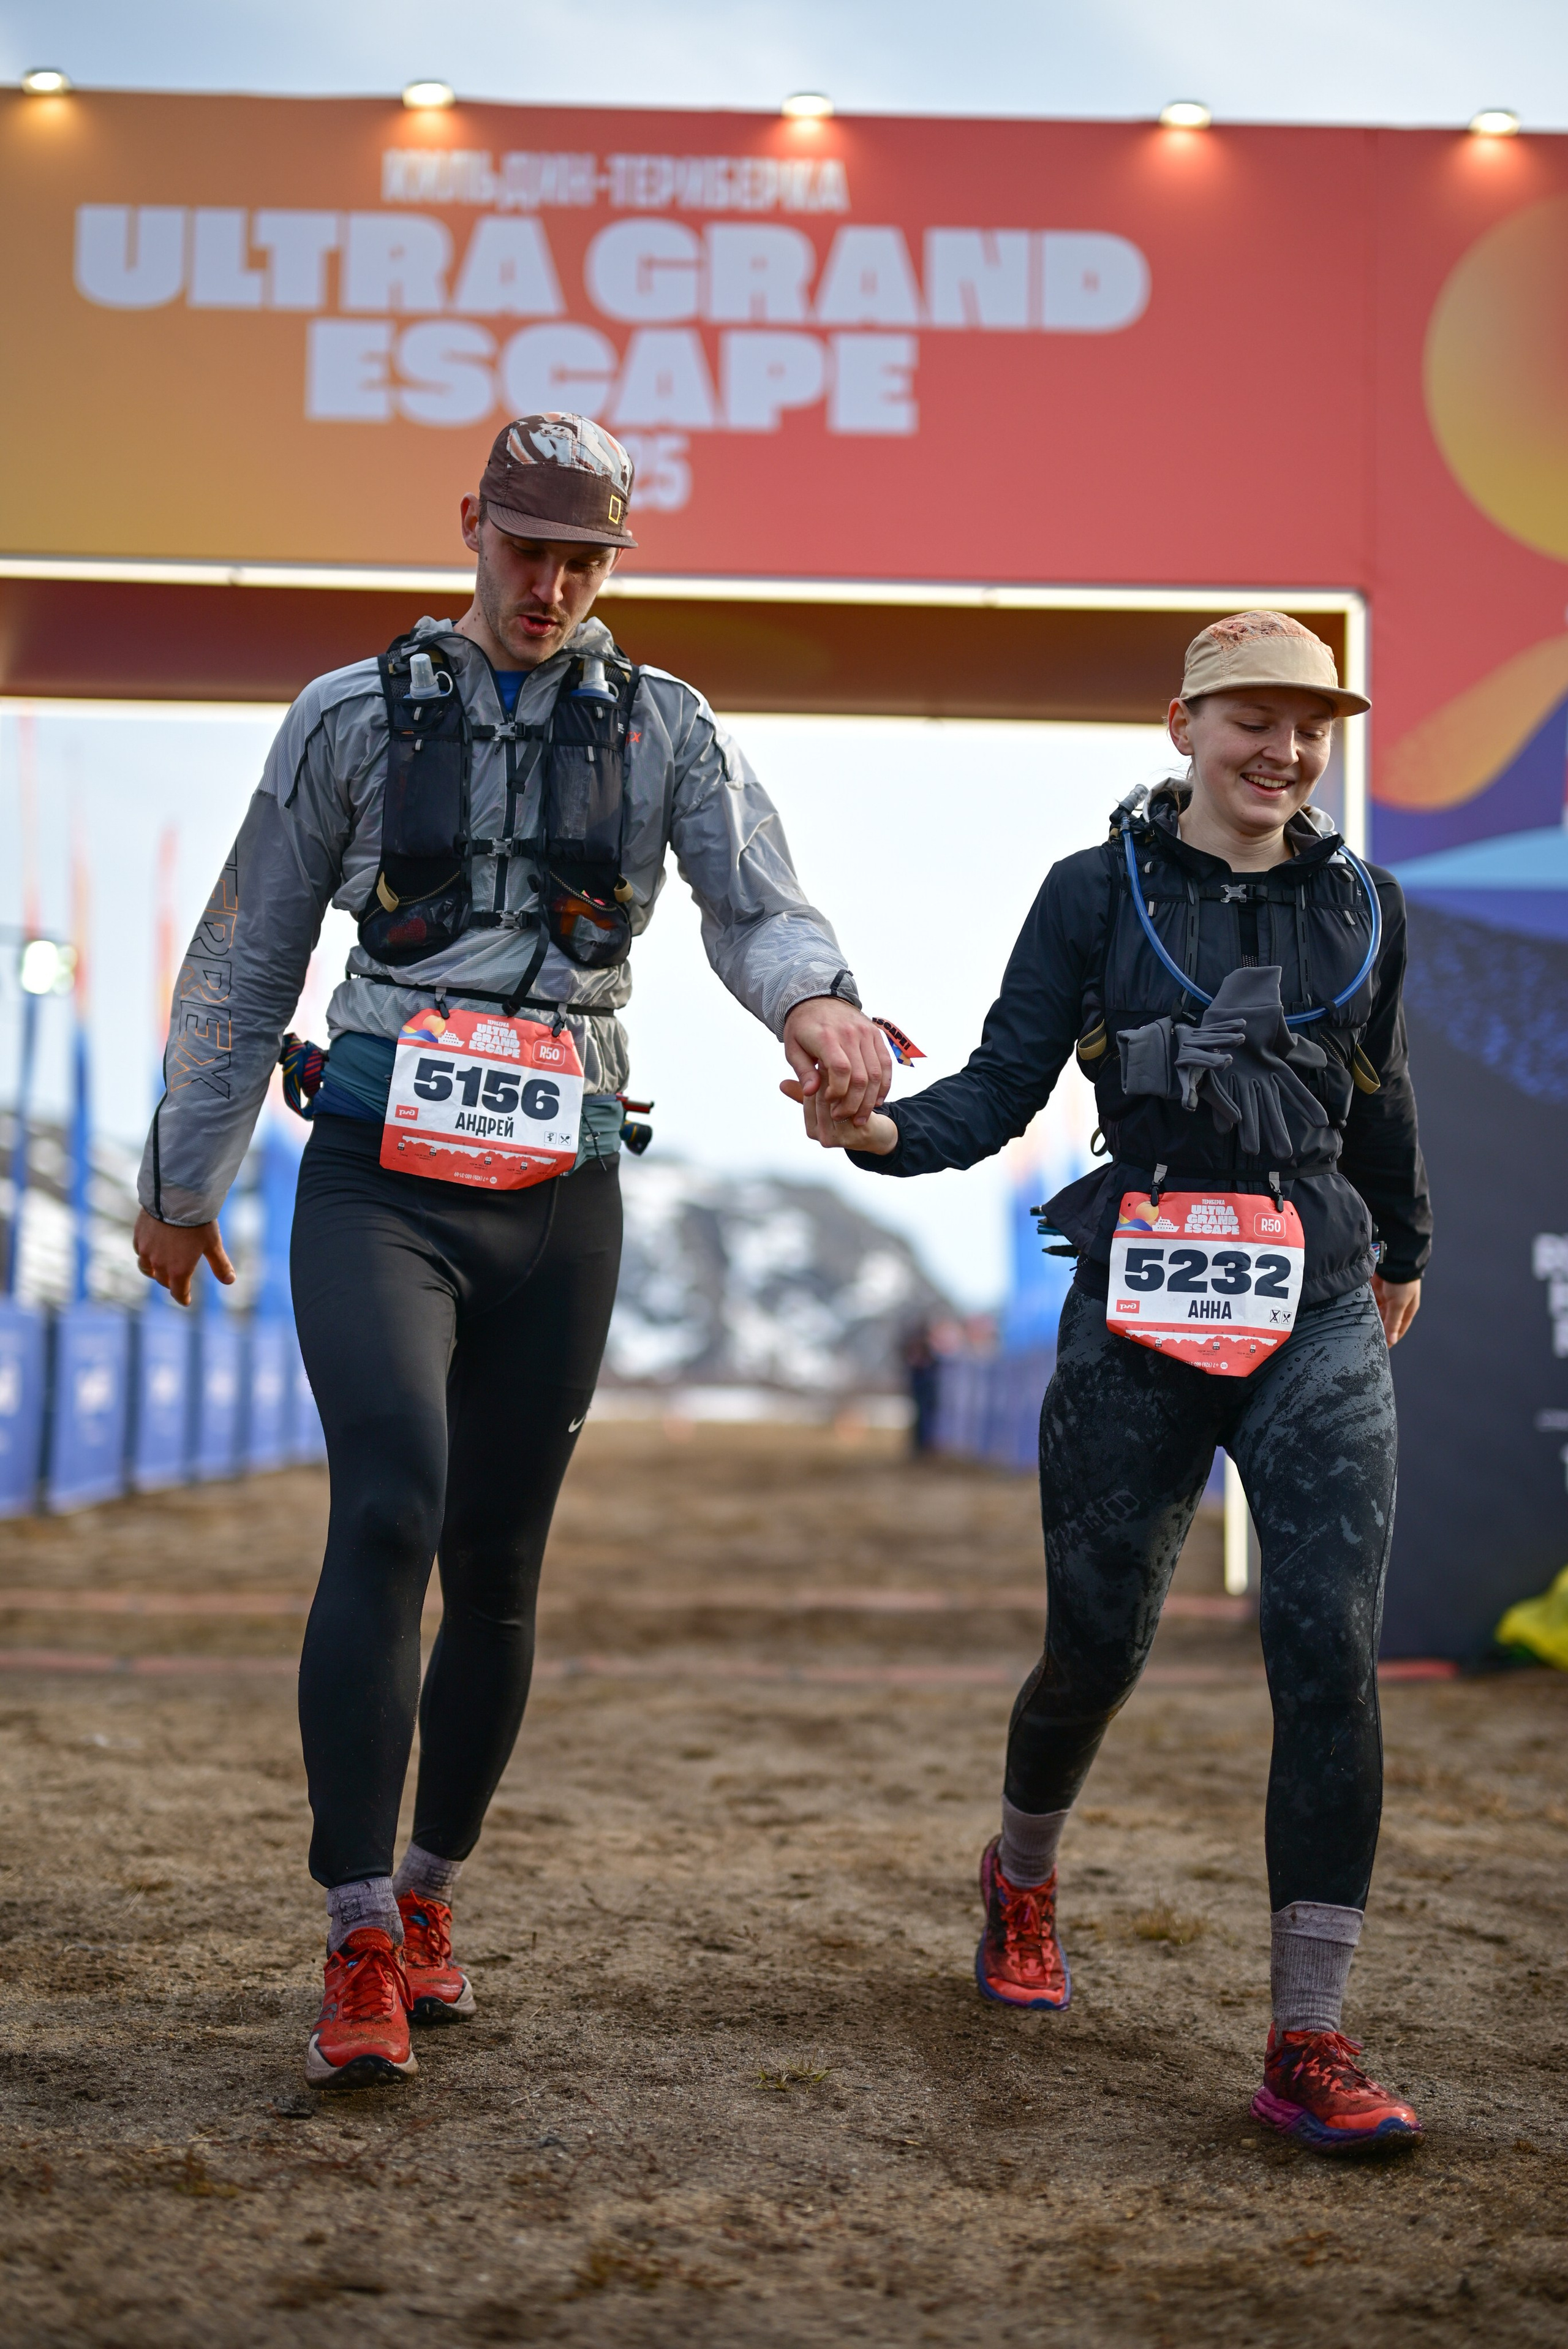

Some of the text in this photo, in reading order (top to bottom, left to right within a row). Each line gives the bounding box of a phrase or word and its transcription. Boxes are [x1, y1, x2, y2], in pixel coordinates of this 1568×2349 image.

[74, 204, 1152, 334] ULTRA GRAND
[305, 318, 918, 436] ESCAPE
[617, 434, 693, 512] 25
[477, 1023, 518, 1040] ULTRA
[488, 1019, 510, 1028] ТЕРИБЕРКА
[472, 1032, 520, 1048] GRAND
[469, 1040, 520, 1059] ESCAPE
[539, 1045, 560, 1061] R50
[413, 1057, 560, 1121] 5156
[455, 1112, 514, 1138] АНДРЕЙ
[1186, 1214, 1238, 1225] GRAND
[1191, 1205, 1235, 1216] ULTRA
[1184, 1224, 1240, 1235] ESCAPE
[1261, 1218, 1281, 1233] R50
[1125, 1248, 1291, 1299] 5232
[1188, 1300, 1232, 1319] АННА
